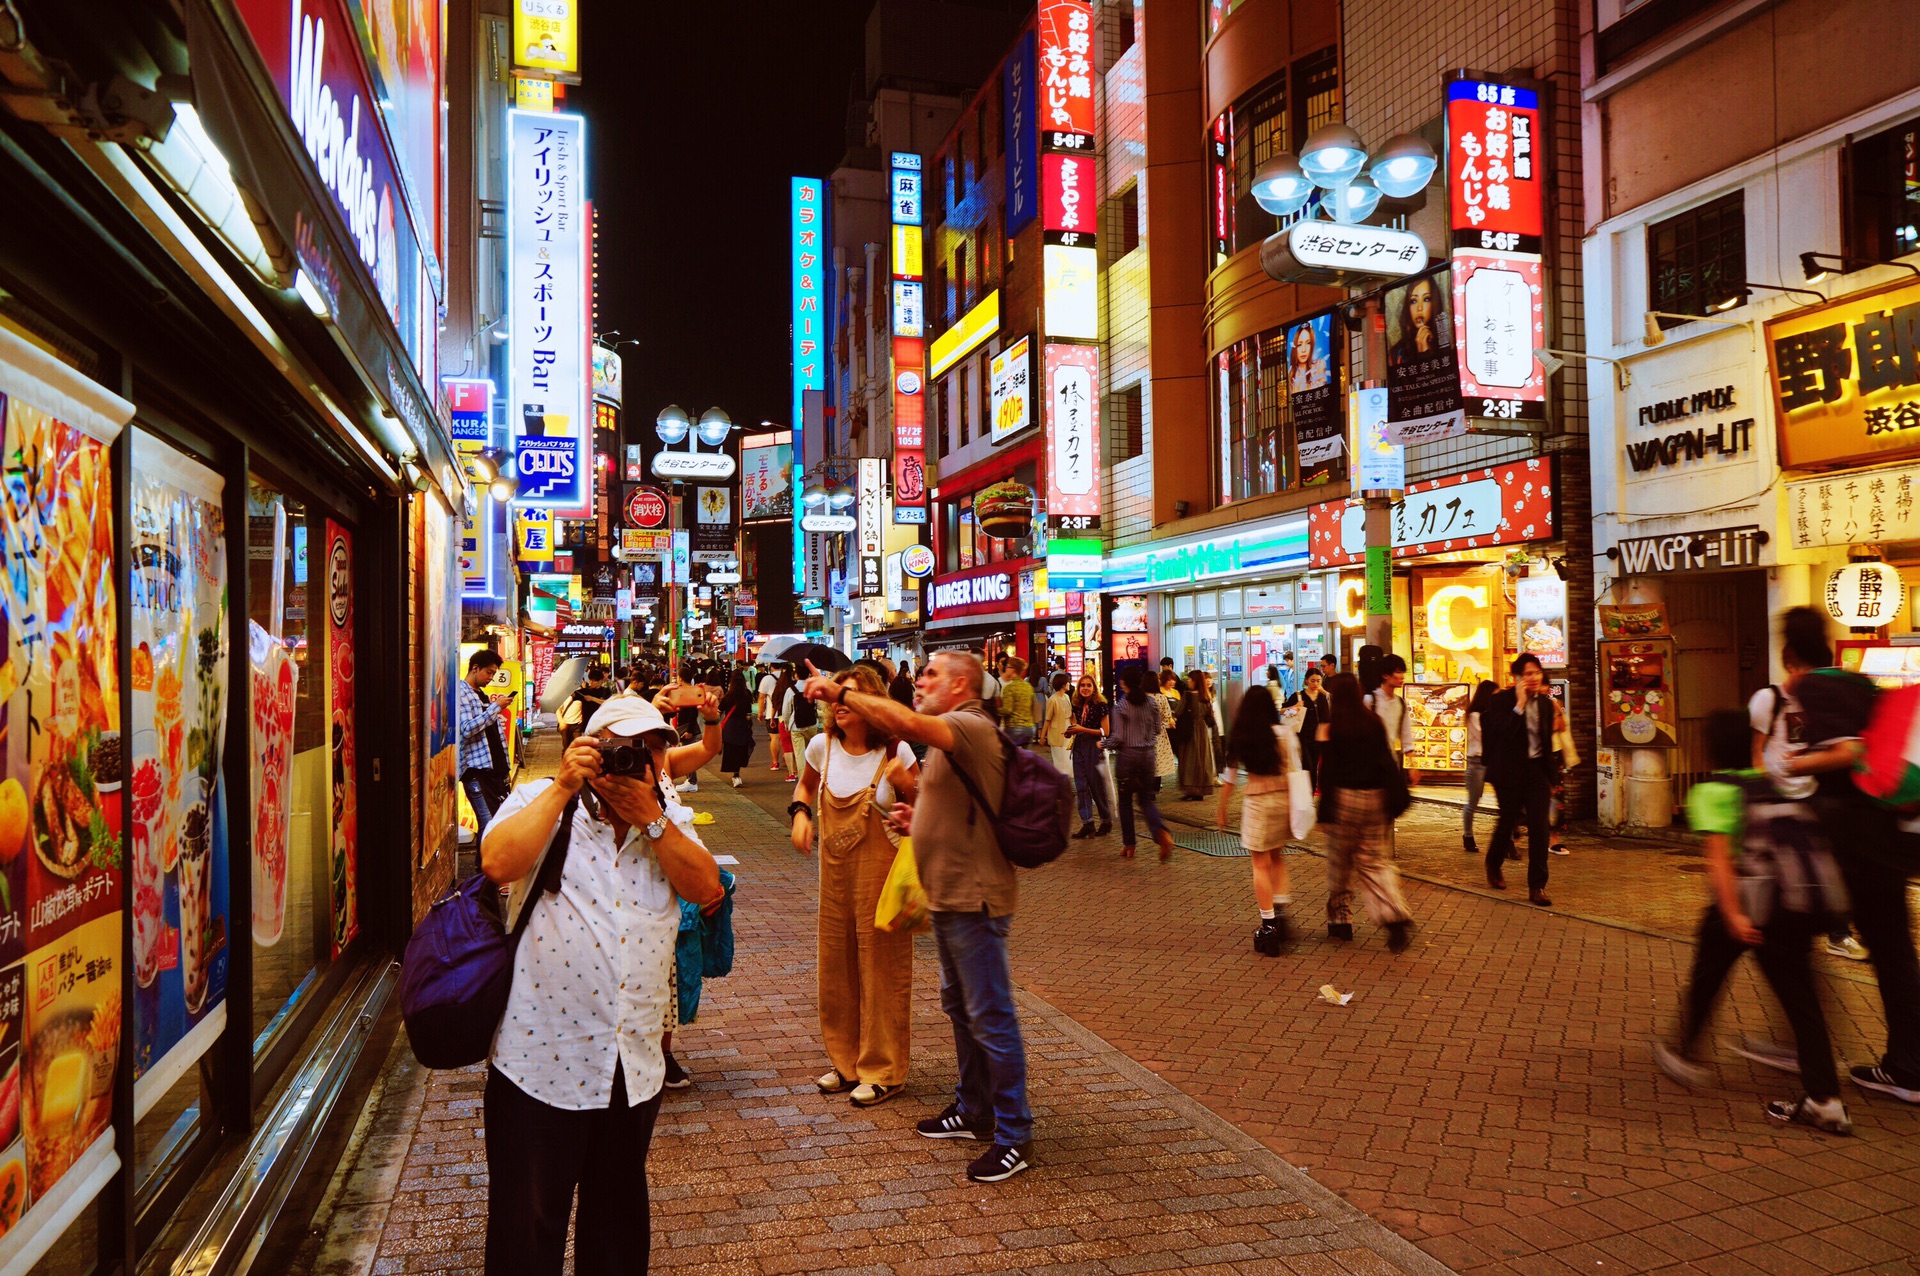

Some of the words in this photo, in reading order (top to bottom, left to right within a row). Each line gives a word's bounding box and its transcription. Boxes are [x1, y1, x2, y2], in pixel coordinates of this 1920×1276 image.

[530, 18, 561, 32] 渋谷店
[1068, 10, 1091, 99] お好み焼
[1046, 45, 1070, 126] もんじゃ
[557, 130, 569, 160] Irish
[1011, 62, 1024, 216] センタービル
[1485, 107, 1511, 211] お好み焼
[899, 178, 914, 216] 麻雀
[1460, 132, 1486, 226] もんじゃ
[557, 212, 569, 233] Bar
[1060, 231, 1080, 247] 4F
[1299, 235, 1420, 262] 渋谷センター街
[1504, 279, 1516, 357] ケーキと
[1483, 315, 1499, 377] お食事
[1401, 398, 1454, 418] 全曲配信中
[1638, 397, 1690, 426] PUBLIC
[1691, 385, 1737, 414] HOUSE
[518, 448, 575, 477] CELTS
[658, 458, 731, 470] 渋谷センター街
[633, 503, 662, 516] 消火栓
[1797, 487, 1811, 546] スタミナ豚丼
[1819, 484, 1833, 545] 豚盛りカレー
[1845, 481, 1858, 543] チャーハン
[1869, 477, 1886, 539] 焼き餃子
[1895, 473, 1914, 523] 唐揚げ
[1360, 496, 1476, 543] 屋カフェ
[908, 551, 929, 561] BURGER
[908, 556, 930, 570] KING
[1145, 538, 1242, 584] FamilyMart
[811, 563, 819, 591] Heart
[935, 579, 971, 608] BURGER
[972, 573, 1010, 602] KING
[1857, 567, 1883, 617] 豚野郎
[1427, 585, 1489, 652] C
[1425, 654, 1490, 685] MEAT
[0, 911, 21, 945] テト
[40, 962, 54, 986] 人気
